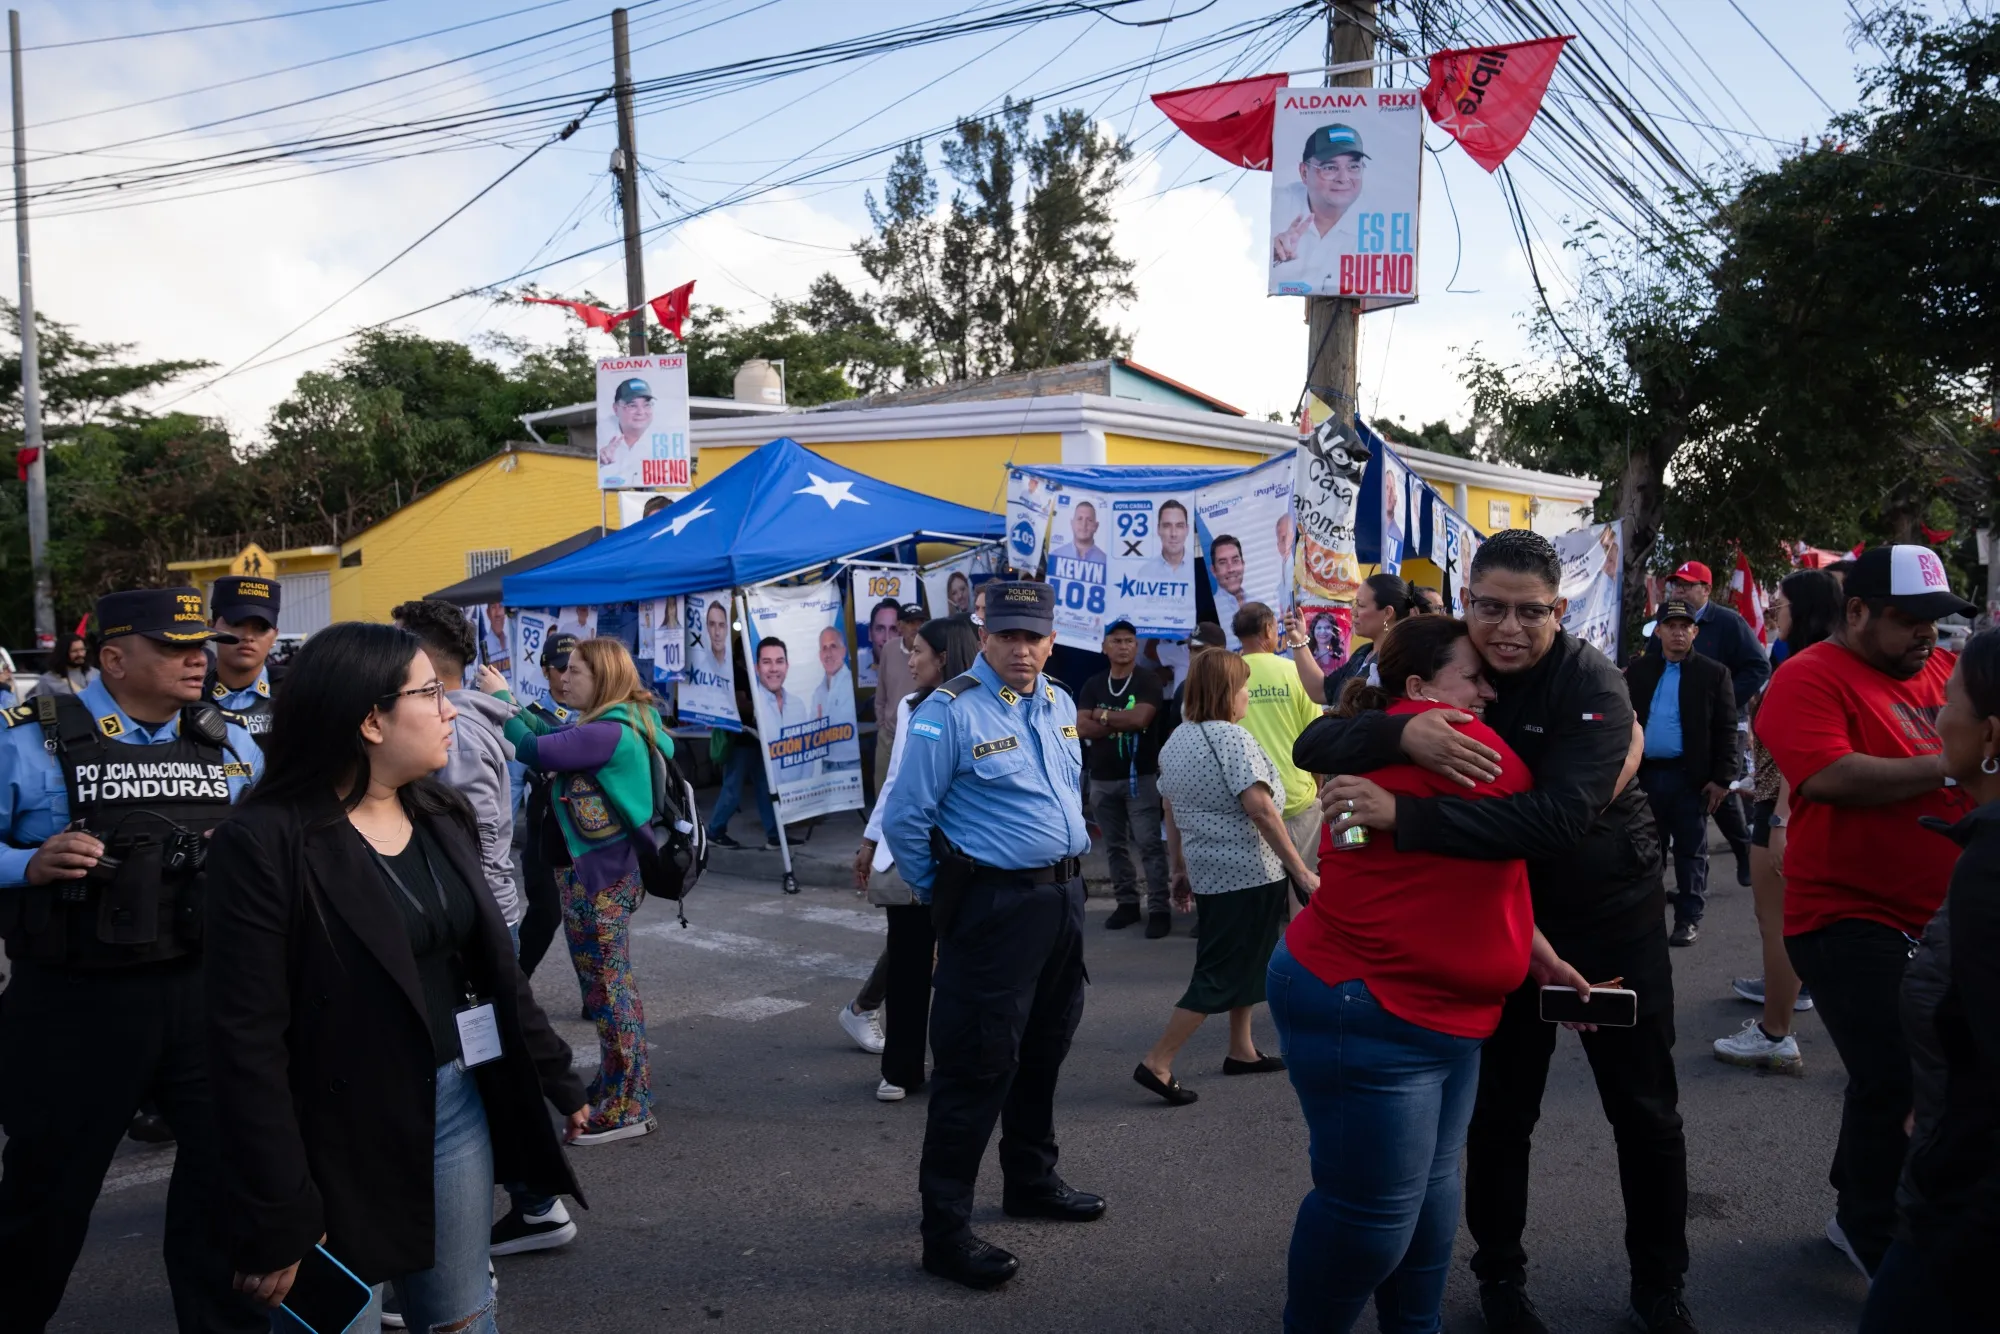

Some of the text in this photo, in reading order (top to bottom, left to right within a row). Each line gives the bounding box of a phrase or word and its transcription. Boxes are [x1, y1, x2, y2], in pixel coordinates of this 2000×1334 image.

[1458, 51, 1508, 115] libre
[1284, 94, 1416, 109] ALDANA RIXI
[1358, 212, 1414, 253] ES EL
[1340, 254, 1413, 295] BUENO
[601, 359, 683, 370] ALDANA RIXI
[652, 433, 687, 459] ES EL
[642, 460, 688, 485] BUENO
[1117, 513, 1149, 537] 93
[1011, 529, 1034, 548] 103
[1055, 557, 1105, 584] KEVYN
[238, 589, 270, 598] NACIONAL
[240, 582, 268, 590] POLICIA
[868, 577, 901, 597] 102
[1008, 588, 1036, 596] POLICIA
[1050, 578, 1106, 614] 108
[1117, 575, 1189, 598] KILVETT
[1005, 594, 1039, 602] NACIONAL
[687, 606, 703, 632] 93
[522, 627, 540, 649] 93
[663, 642, 680, 665] 101
[520, 678, 548, 698] KILVE
[685, 666, 731, 691] KILVETT
[1248, 684, 1290, 697] orbital
[804, 733, 813, 750] Y
[813, 724, 852, 747] CAMBIO
[794, 752, 803, 764] LA
[139, 762, 207, 780] NACIONAL
[208, 765, 225, 780] DE
[78, 779, 229, 802] HONDURAS
